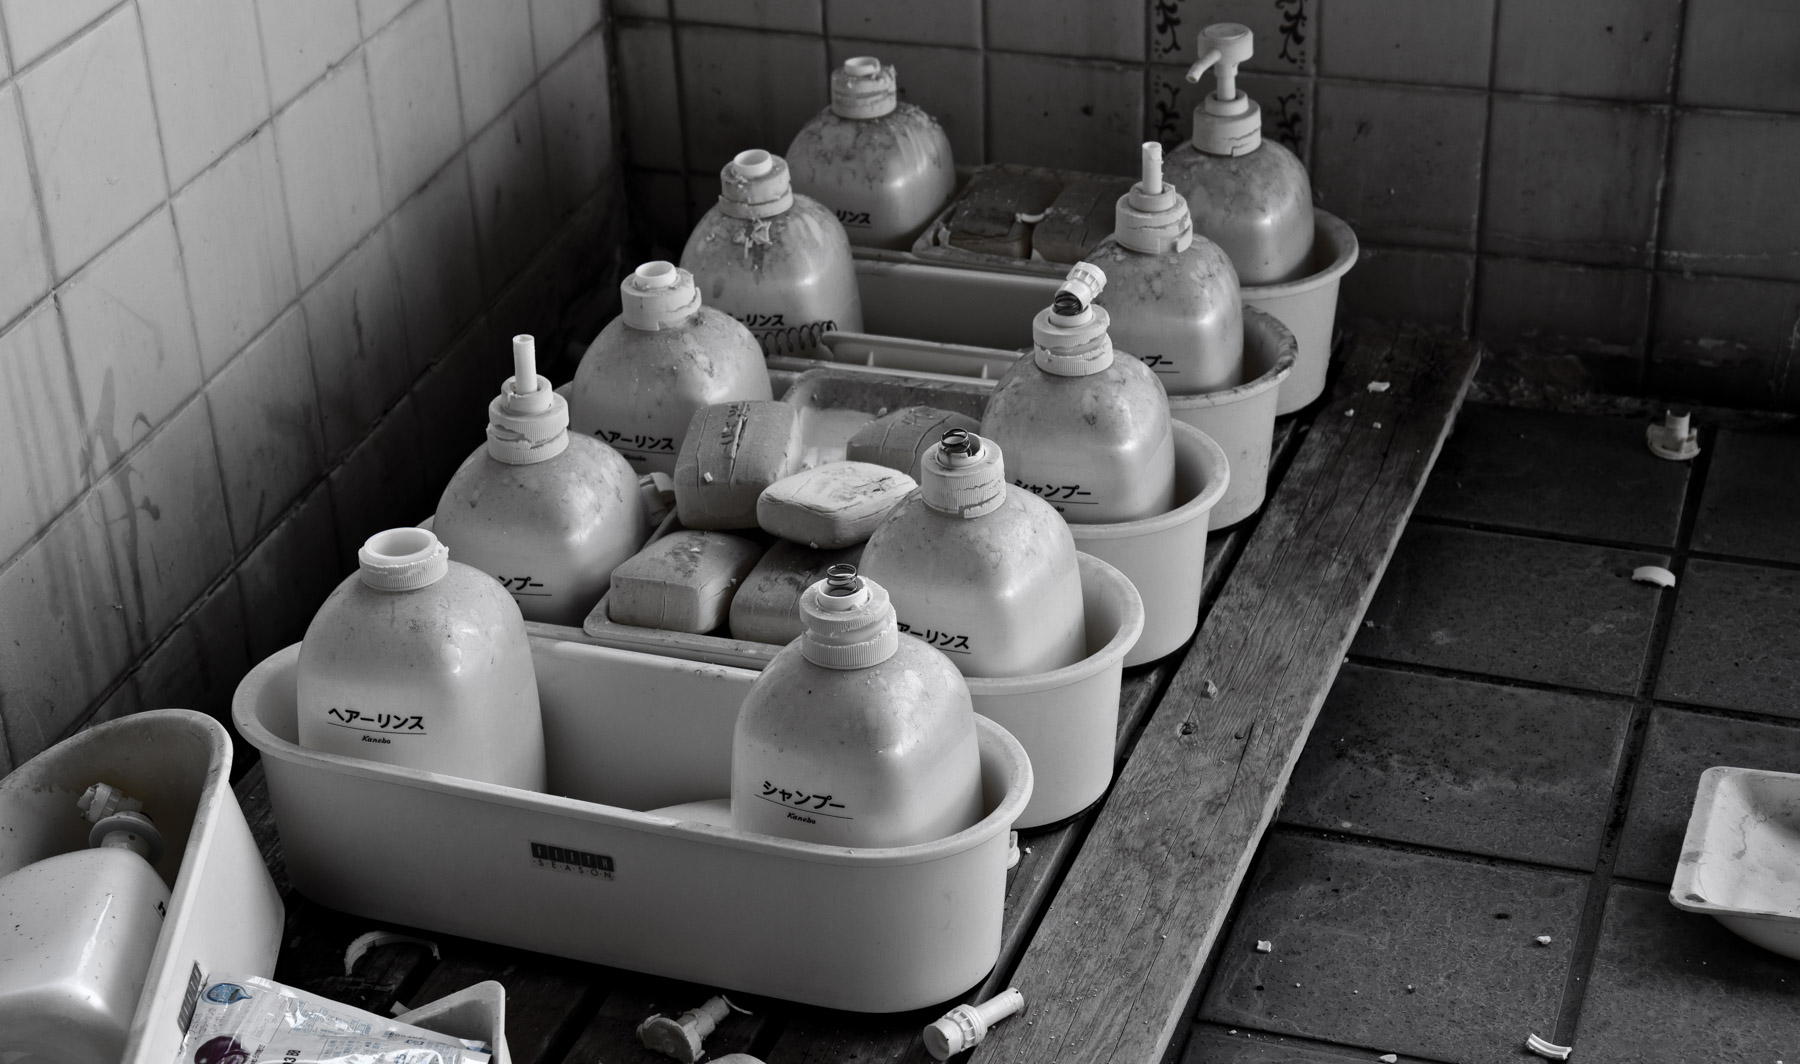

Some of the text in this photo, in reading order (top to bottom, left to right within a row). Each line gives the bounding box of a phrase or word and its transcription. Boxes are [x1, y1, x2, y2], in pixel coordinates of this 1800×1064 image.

[595, 430, 674, 450] ヘアーリンス
[328, 708, 424, 730] ヘアーリンス
[361, 735, 391, 744] Kanebo
[762, 780, 845, 809] シャンプー
[787, 812, 816, 825] Kanebo
